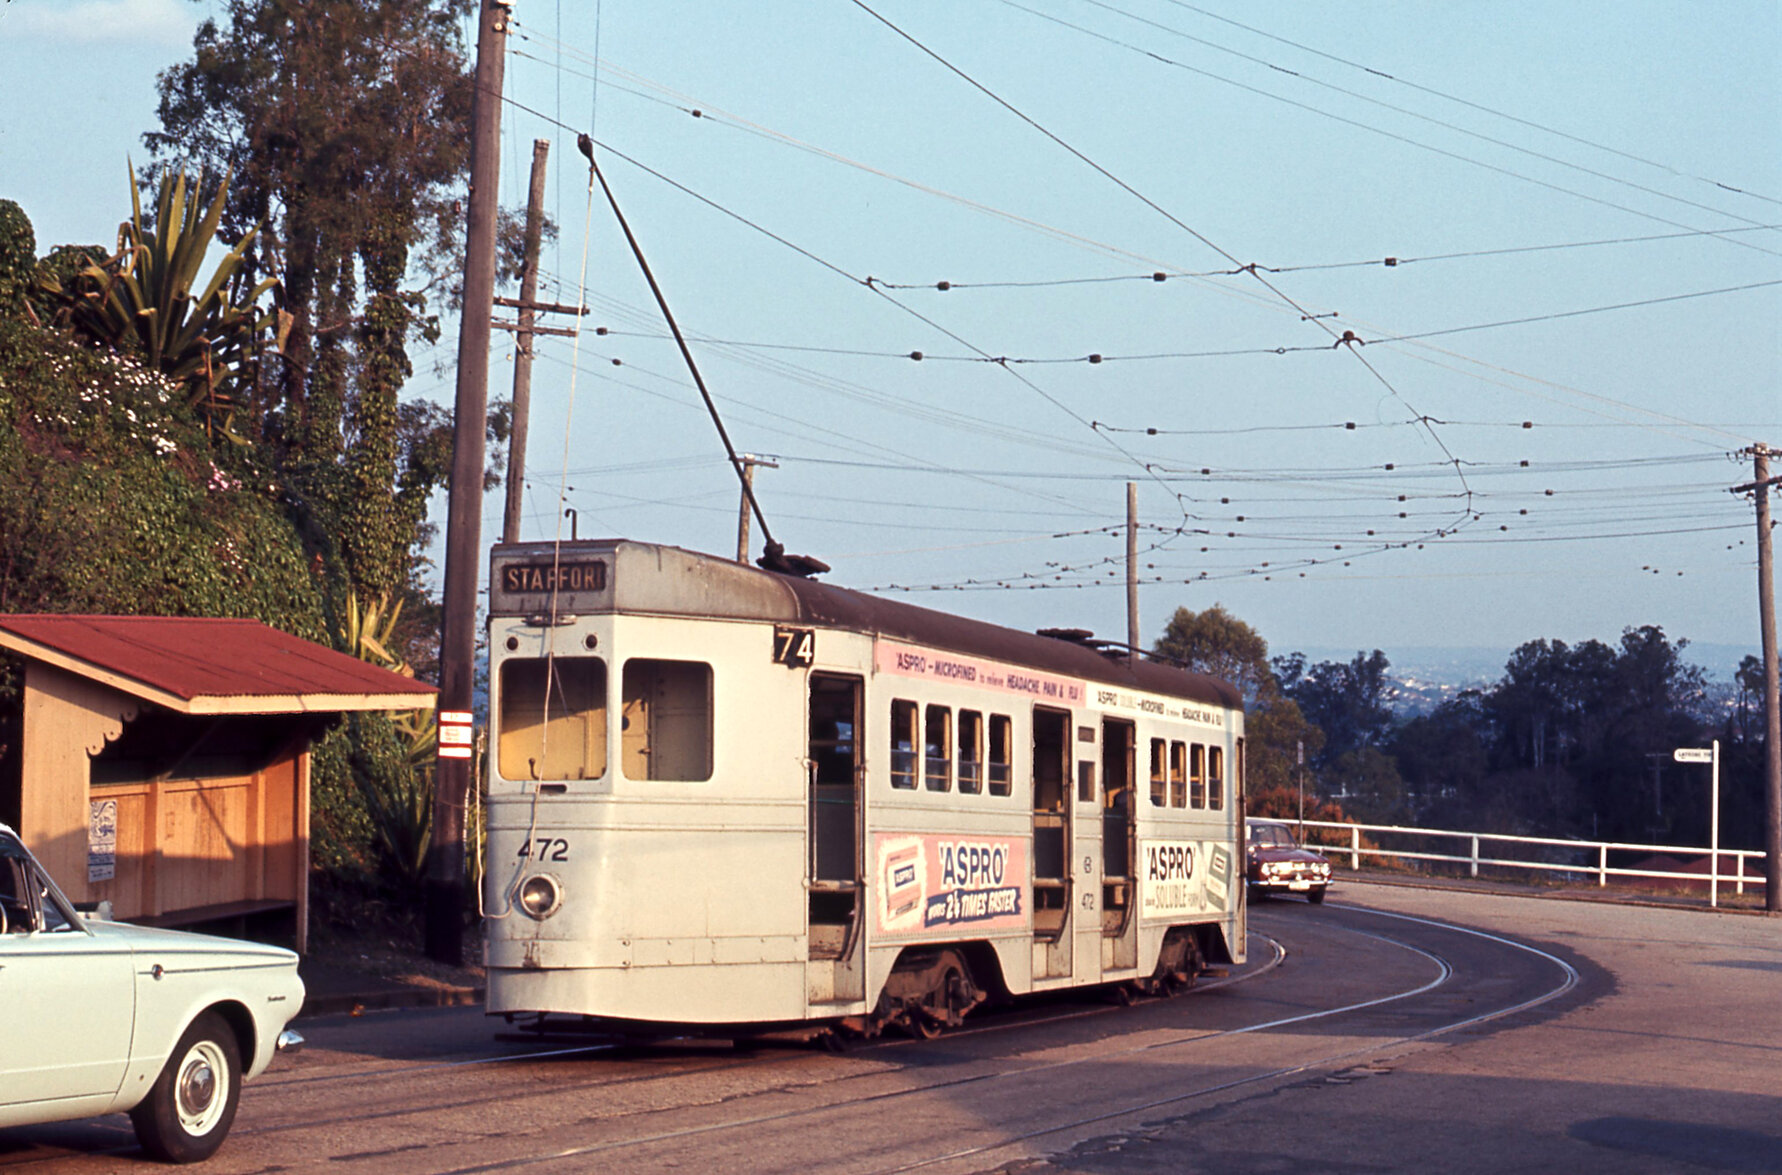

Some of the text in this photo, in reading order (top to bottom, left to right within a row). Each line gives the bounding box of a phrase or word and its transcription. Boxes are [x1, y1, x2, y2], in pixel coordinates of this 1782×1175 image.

[777, 632, 812, 663] 74
[517, 838, 568, 861] 472
[960, 893, 987, 917] TIMES
[987, 889, 1017, 915] FASTER
